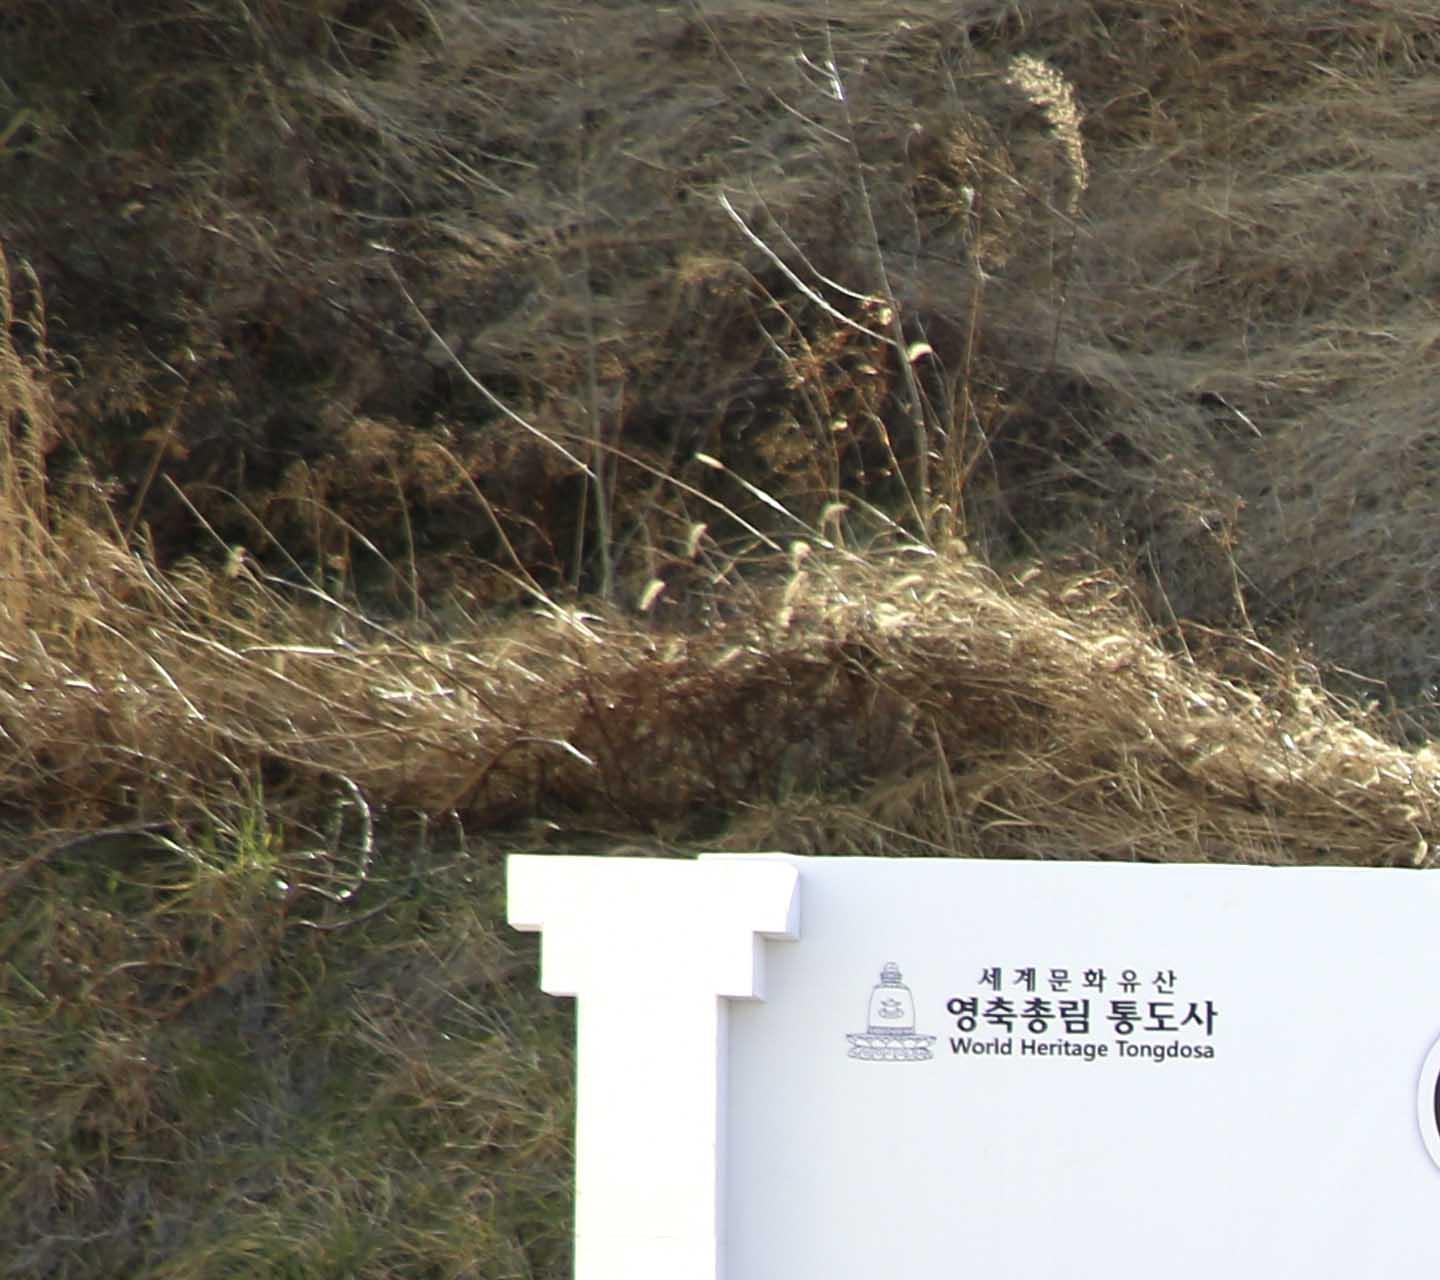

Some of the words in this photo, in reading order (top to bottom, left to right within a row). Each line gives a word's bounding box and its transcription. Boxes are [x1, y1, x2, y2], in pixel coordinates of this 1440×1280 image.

[978, 967, 1177, 994] 세계문화유산
[946, 997, 1090, 1034] 영축총림
[1106, 999, 1219, 1036] 통도사
[949, 1037, 1013, 1056] World
[1020, 1038, 1109, 1061] Heritage
[1114, 1040, 1215, 1062] Tongdosa
